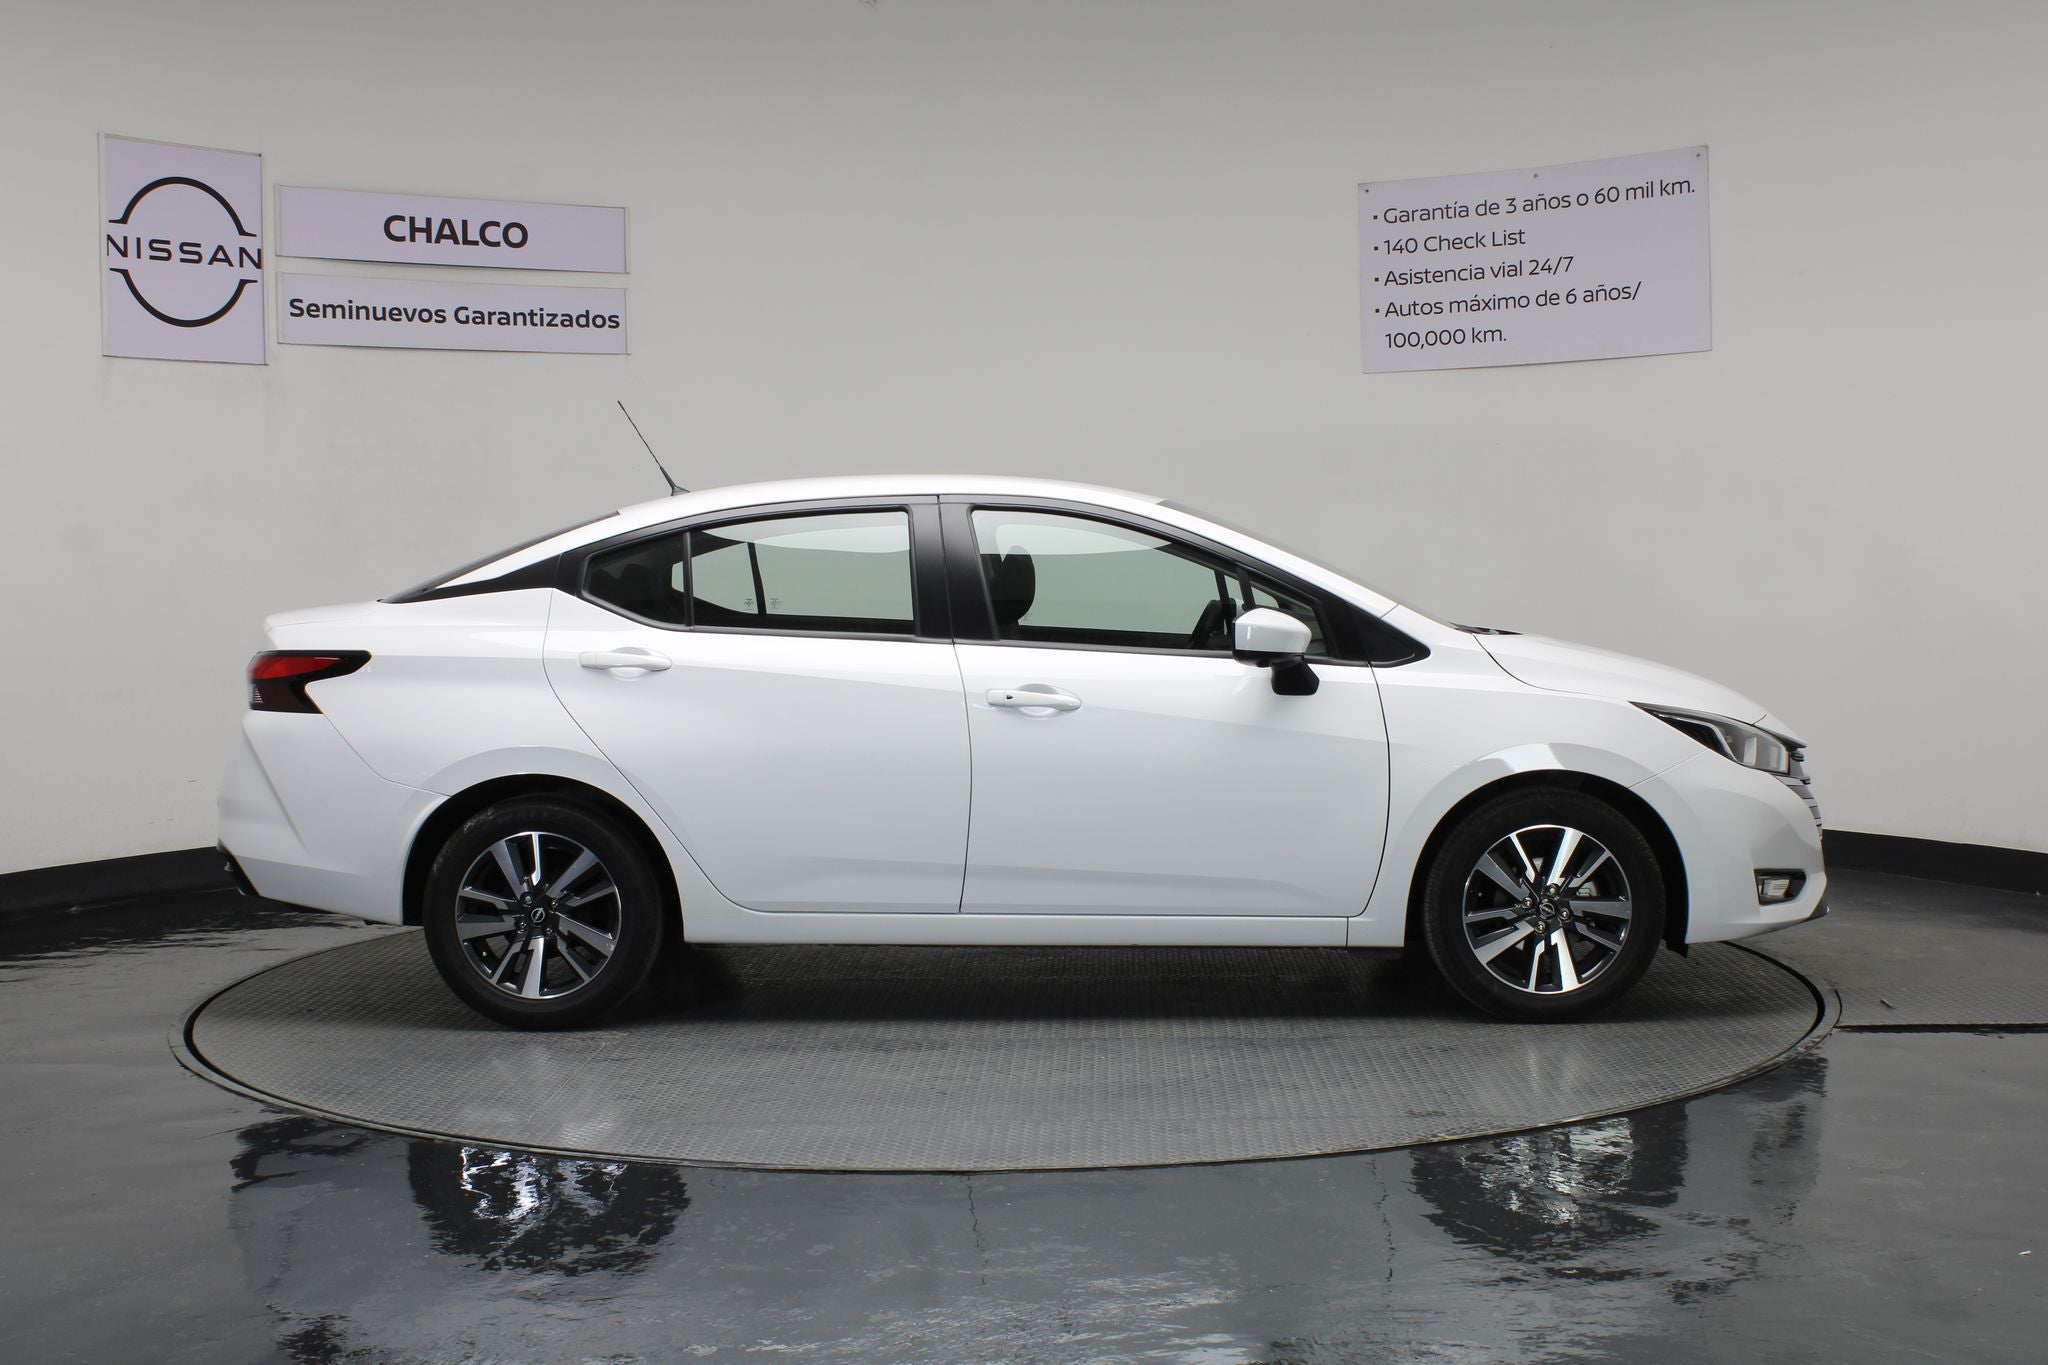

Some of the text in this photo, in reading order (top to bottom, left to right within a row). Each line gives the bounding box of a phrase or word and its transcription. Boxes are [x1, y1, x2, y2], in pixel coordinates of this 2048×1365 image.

[1383, 179, 1696, 224] Garantía de 3 años o 60 mil km.
[383, 214, 529, 249] CHALCO
[1383, 228, 1527, 256] 140 Check List
[106, 233, 263, 270] NISSAN
[1383, 255, 1574, 287] Asistencia vial 24/7
[289, 297, 621, 330] Seminuevos Garantizados
[1384, 280, 1642, 318] Autos máximo de 6 años/
[1384, 326, 1507, 350] 100,000 km.
